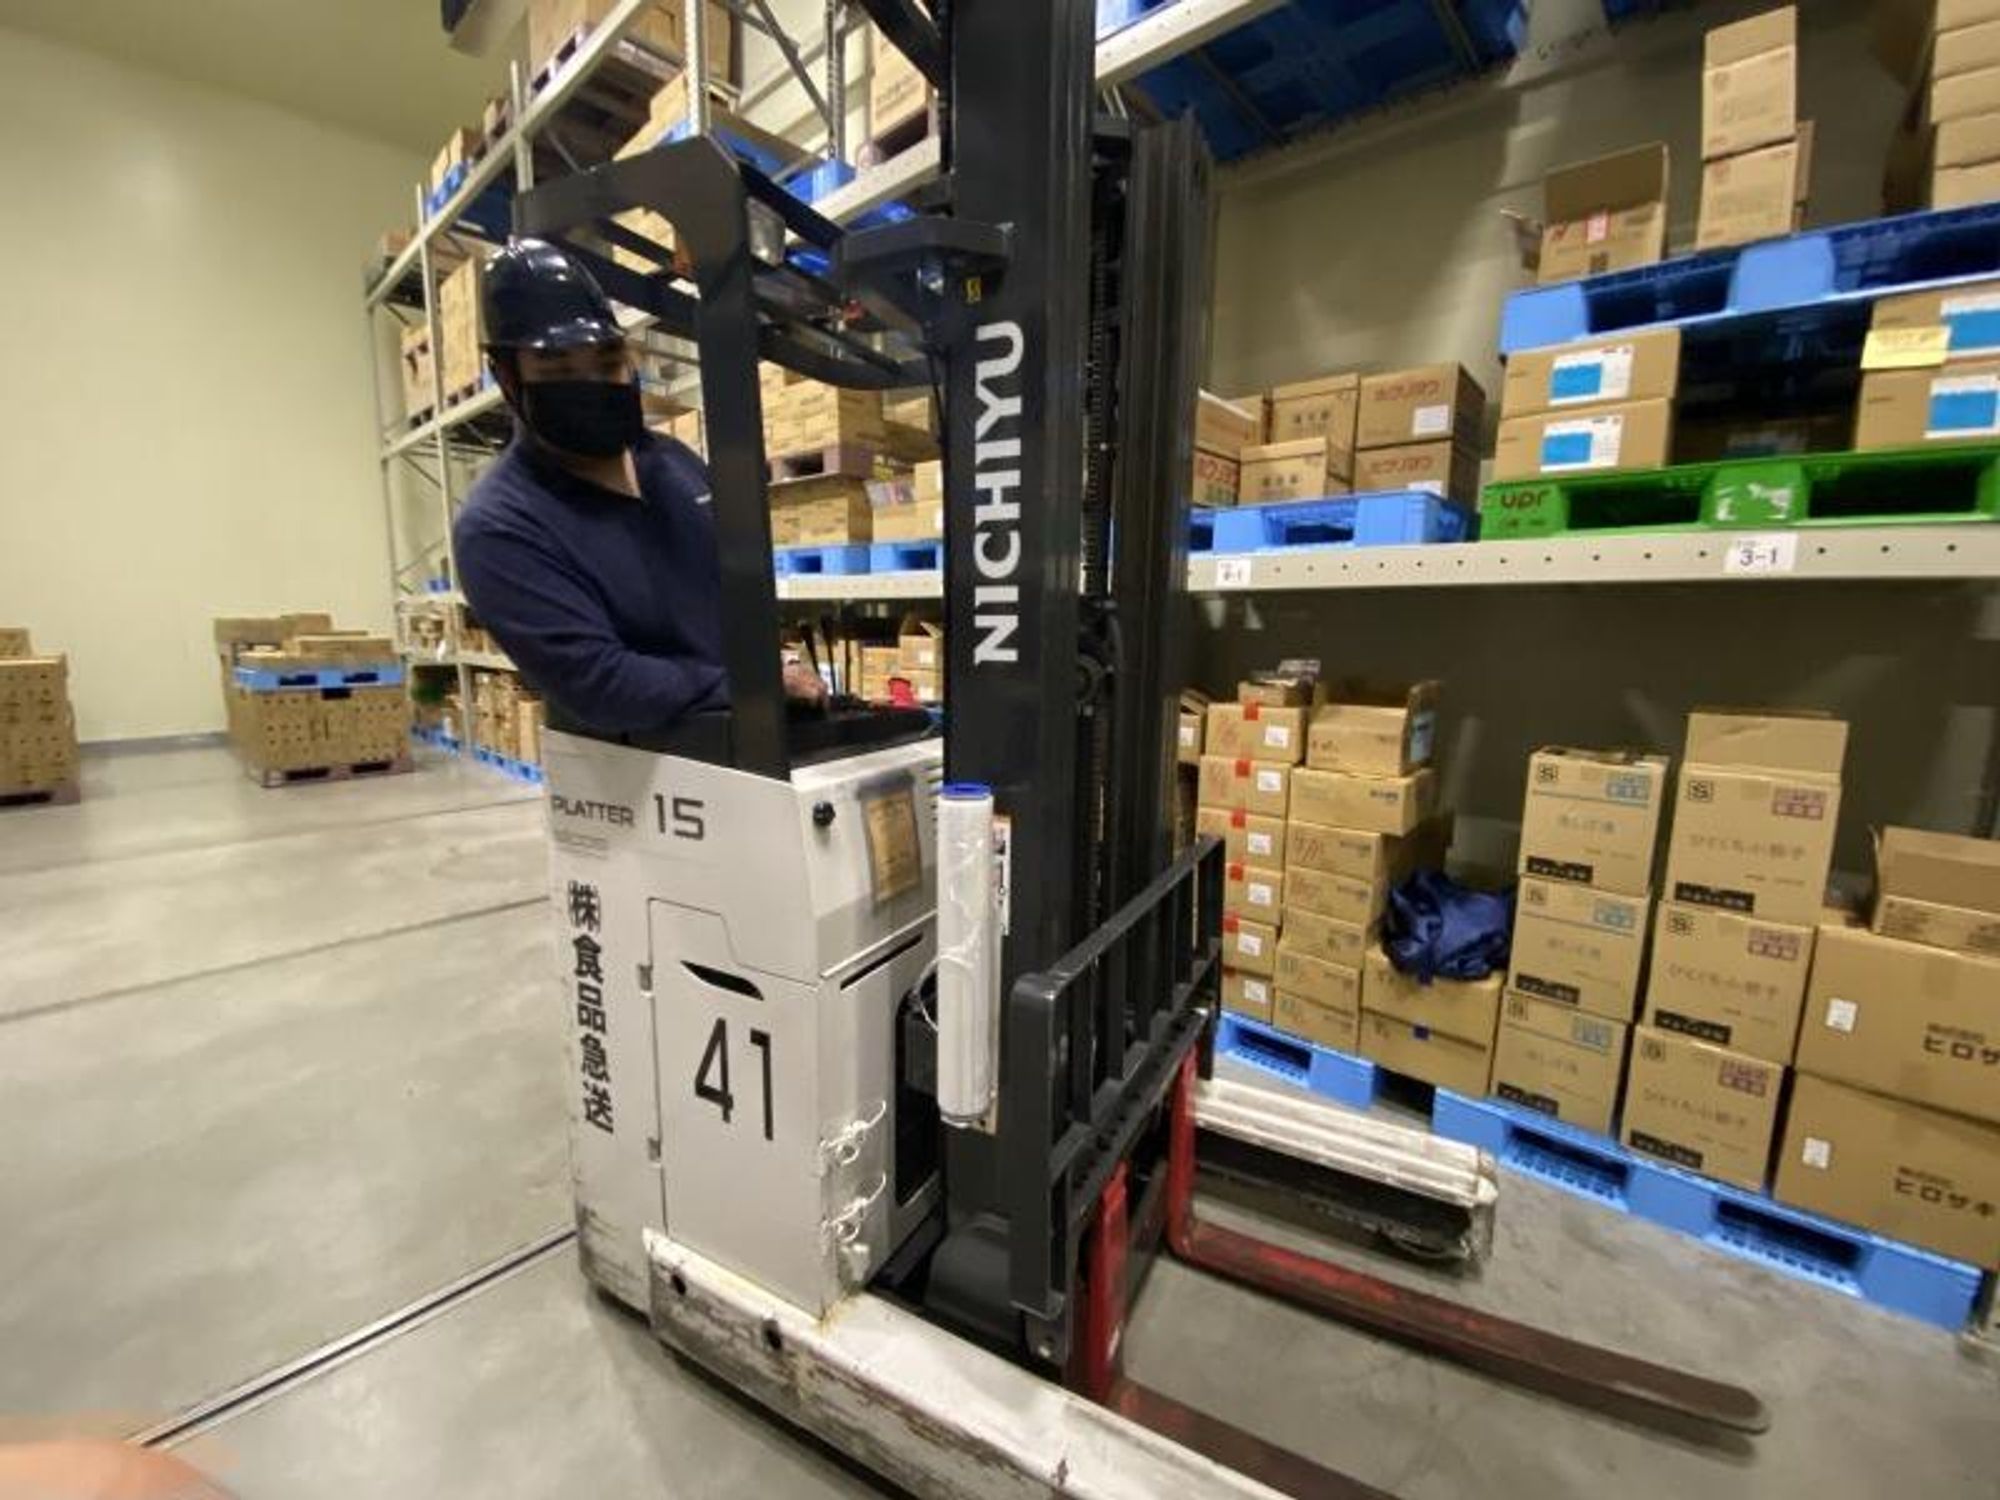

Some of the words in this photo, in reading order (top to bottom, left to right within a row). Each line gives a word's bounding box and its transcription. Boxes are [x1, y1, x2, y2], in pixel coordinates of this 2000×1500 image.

[973, 319, 1025, 664] NICHIYU
[1499, 488, 1551, 510] upr
[1738, 548, 1780, 567] 3-1
[551, 794, 636, 828] PLATTER
[653, 792, 705, 841] 15
[693, 1016, 774, 1142] 41
